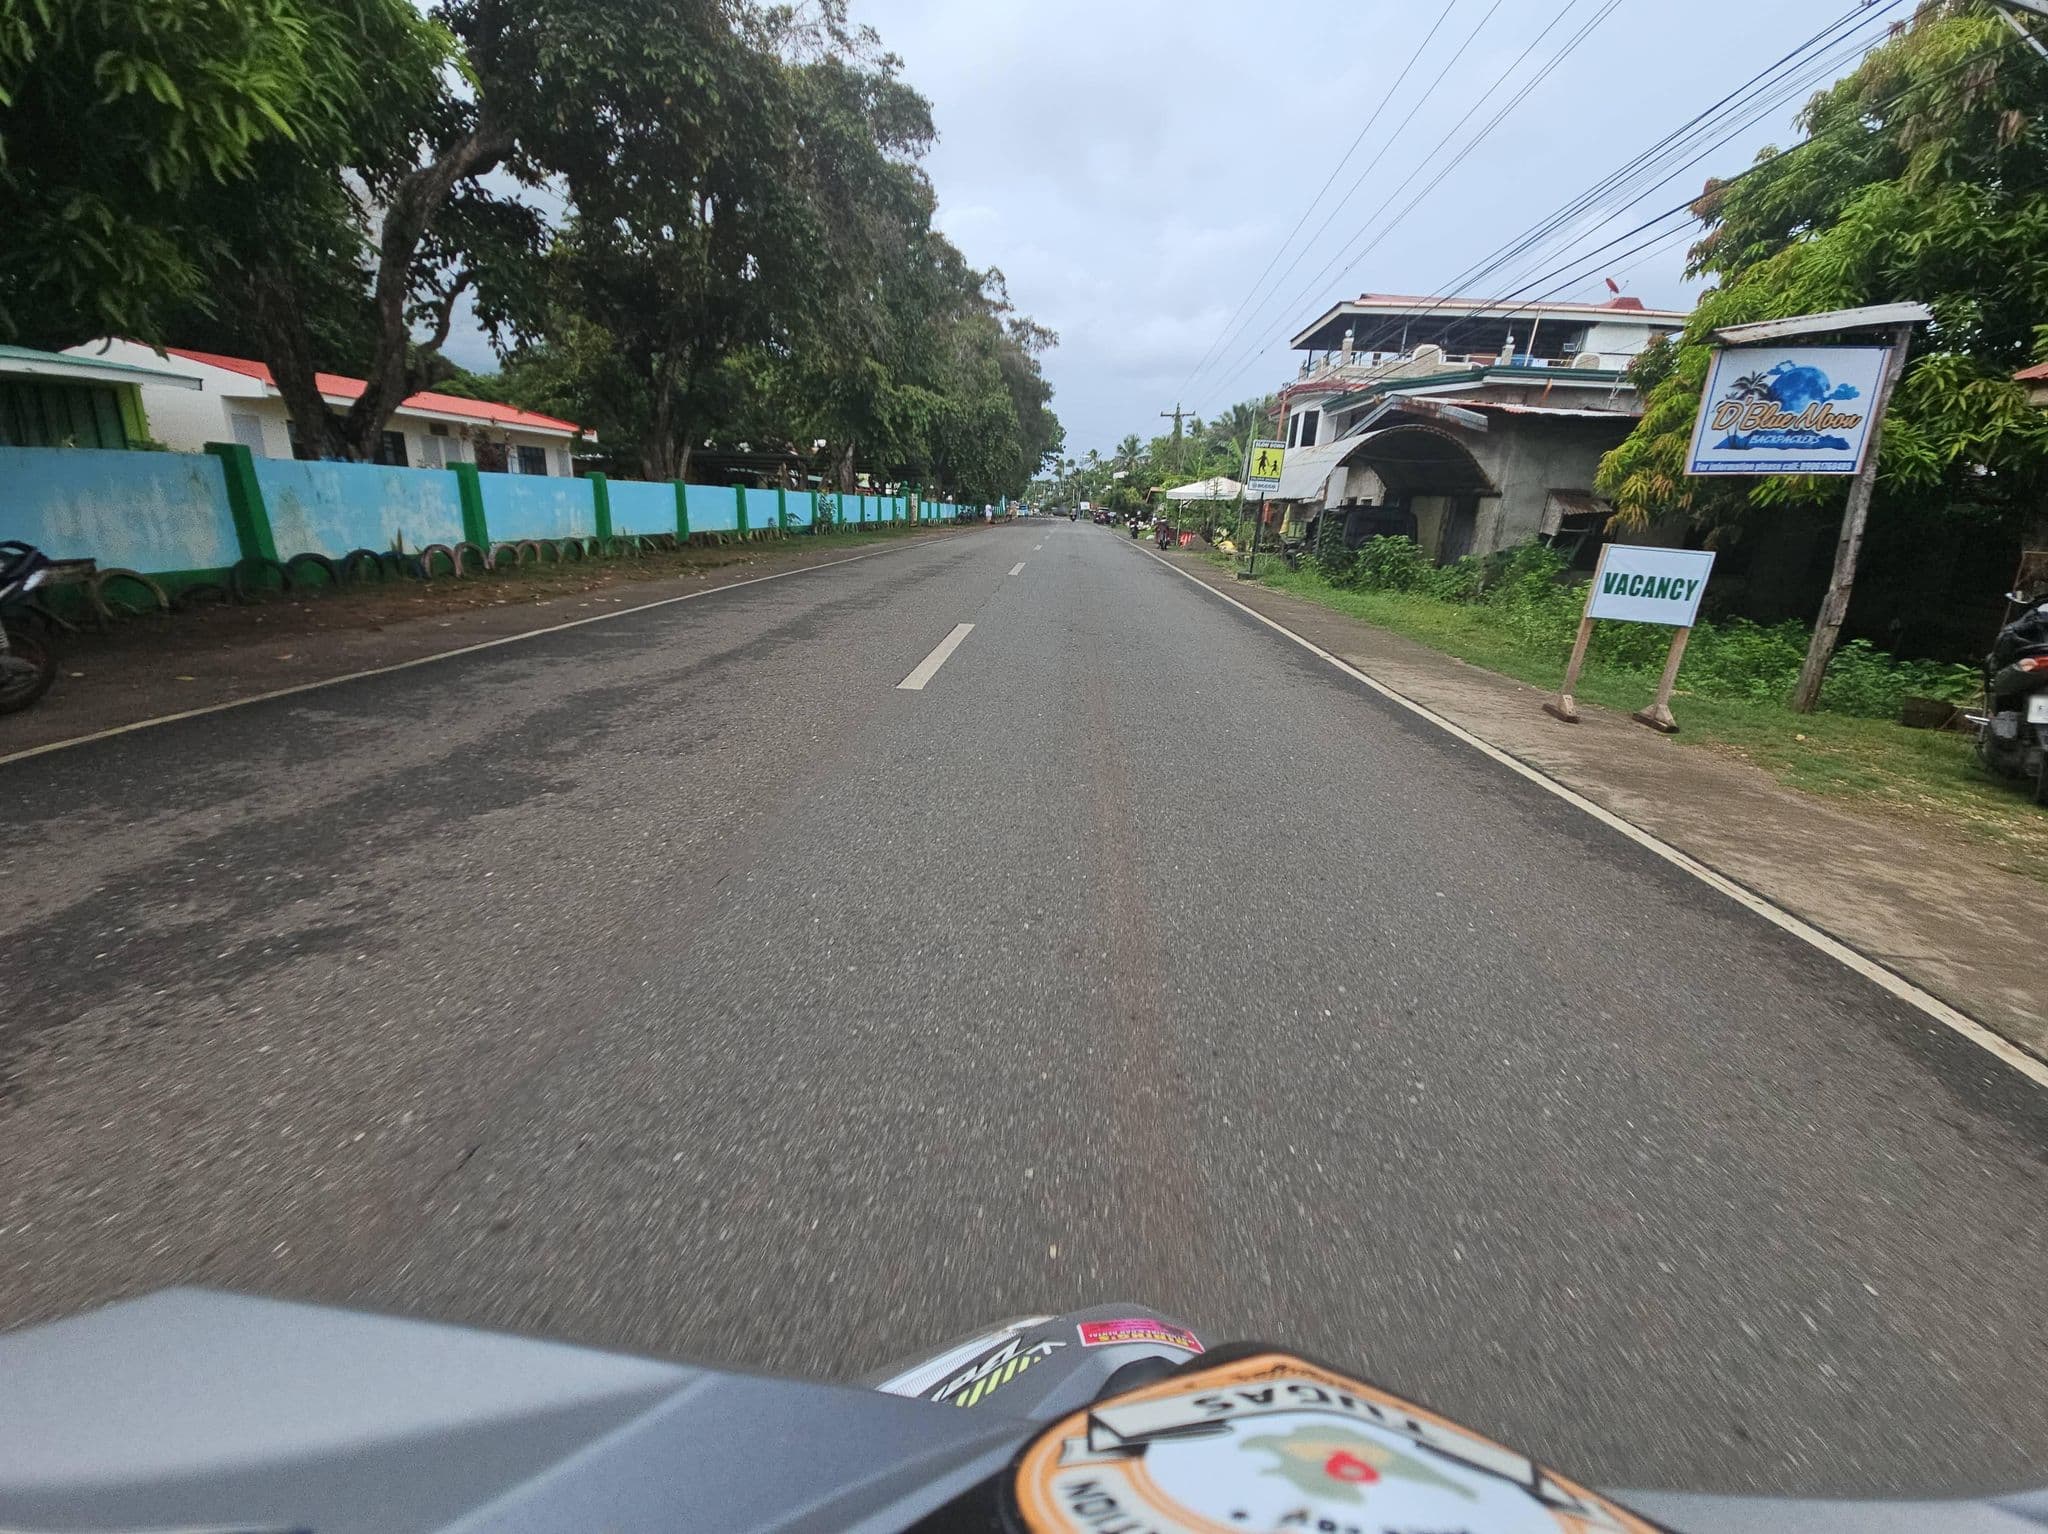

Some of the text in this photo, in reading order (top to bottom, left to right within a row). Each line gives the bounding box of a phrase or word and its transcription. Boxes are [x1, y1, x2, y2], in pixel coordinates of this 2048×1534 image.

[1795, 401, 1863, 432] Moon
[1749, 434, 1821, 445] BACKPACKERS
[1603, 572, 1700, 601] VACANCY
